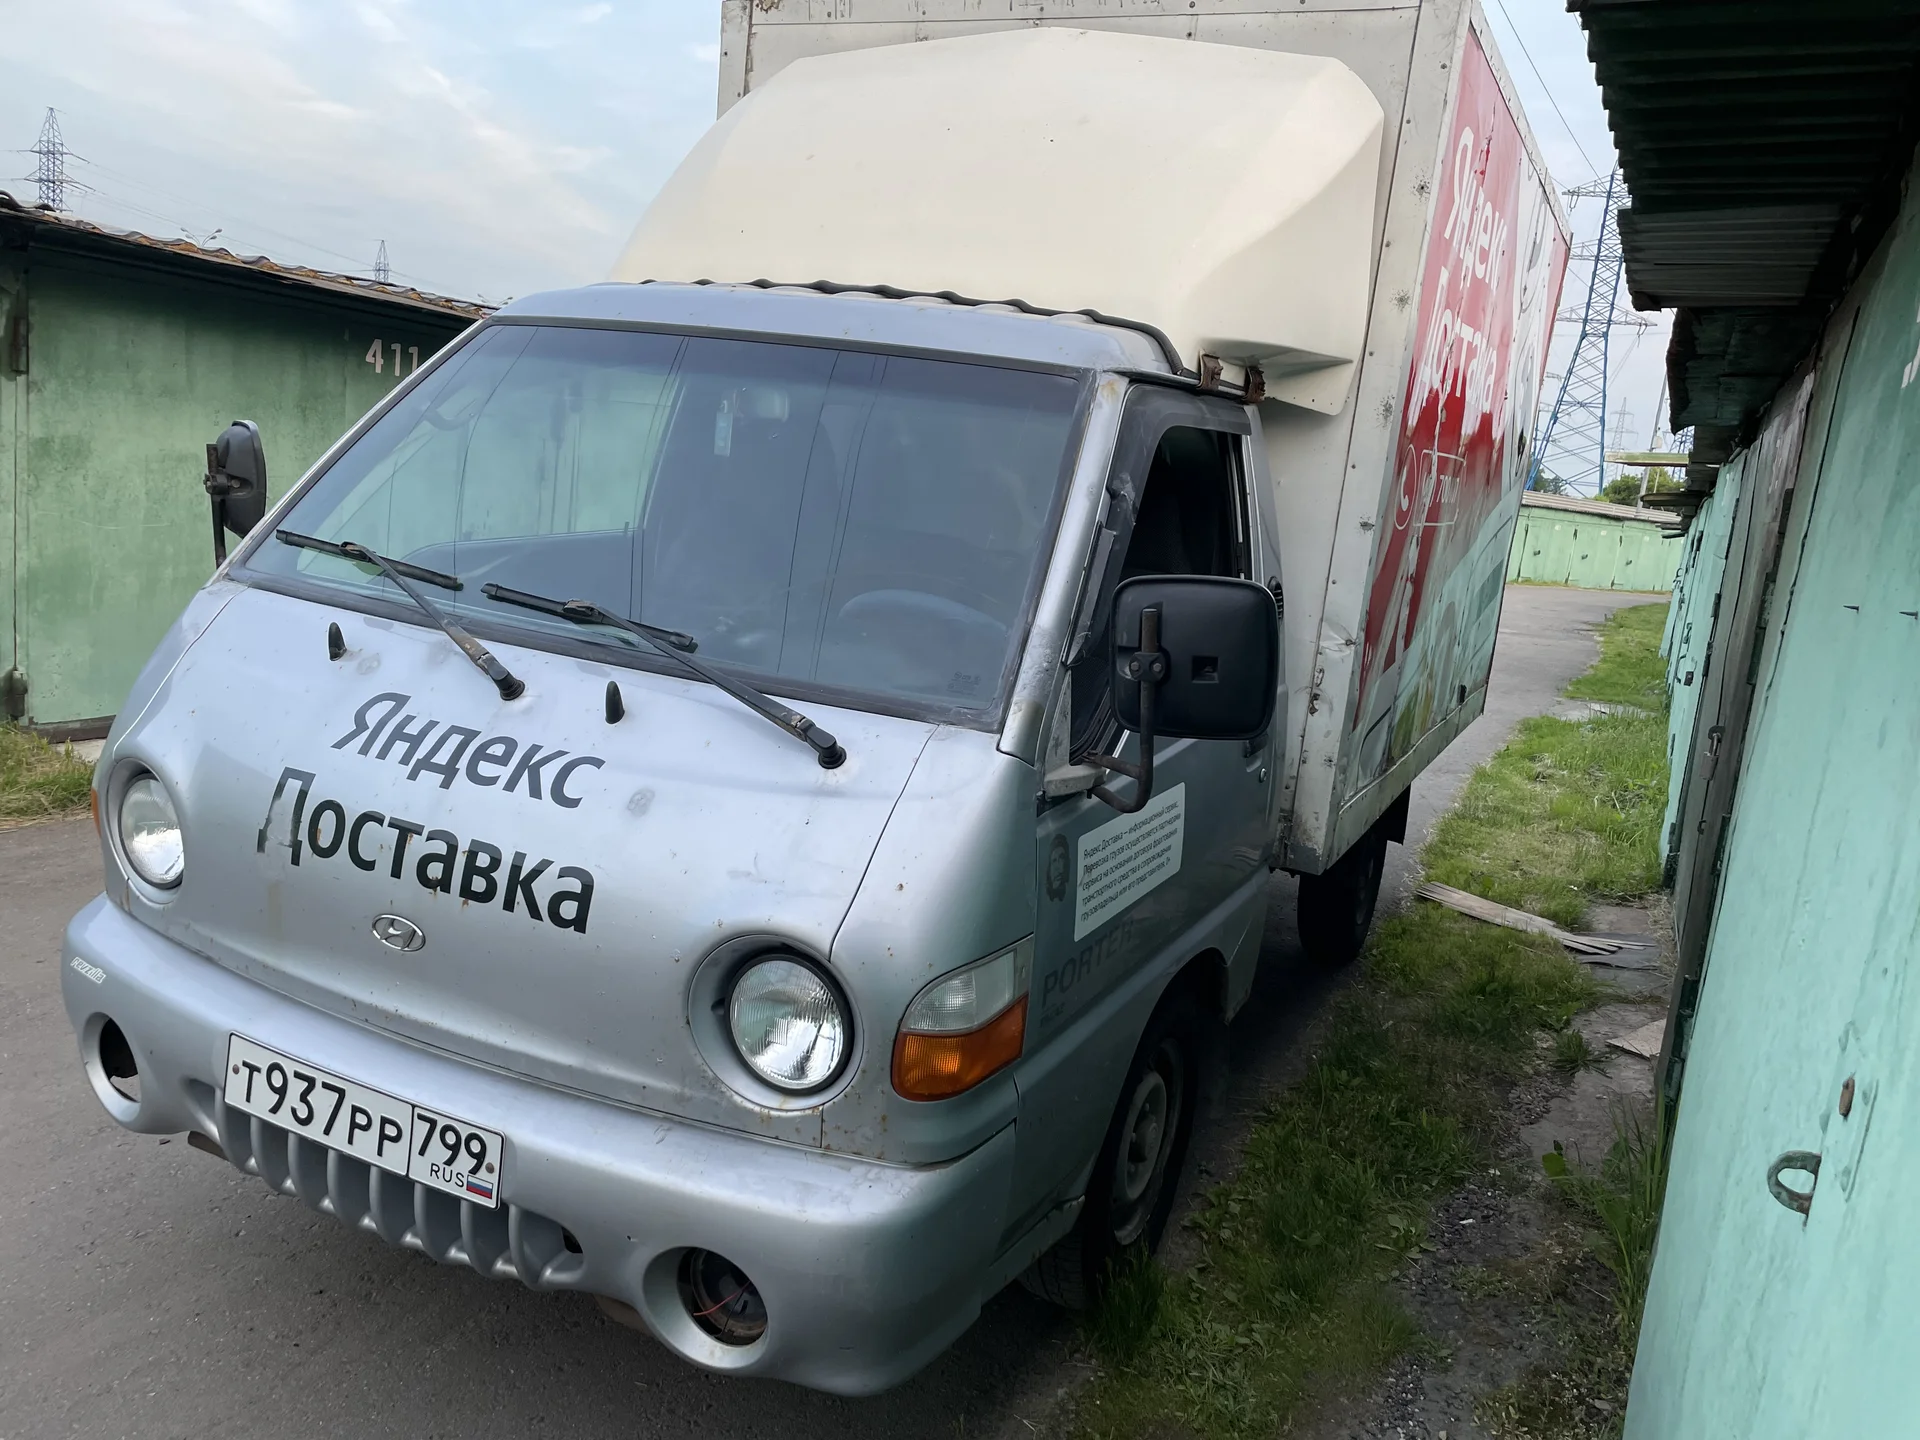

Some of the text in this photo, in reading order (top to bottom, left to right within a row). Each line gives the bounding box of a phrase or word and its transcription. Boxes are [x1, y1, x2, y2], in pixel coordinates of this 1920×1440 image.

[365, 338, 419, 376] 411
[330, 691, 606, 808] Яндекс
[256, 766, 595, 934] Доставка
[1083, 844, 1102, 860] Яндекс
[1102, 832, 1124, 852] Доставка
[1110, 845, 1125, 861] грузов
[1041, 920, 1134, 1009] PORTER
[417, 1112, 487, 1176] 799
[430, 1163, 465, 1188] RUS
